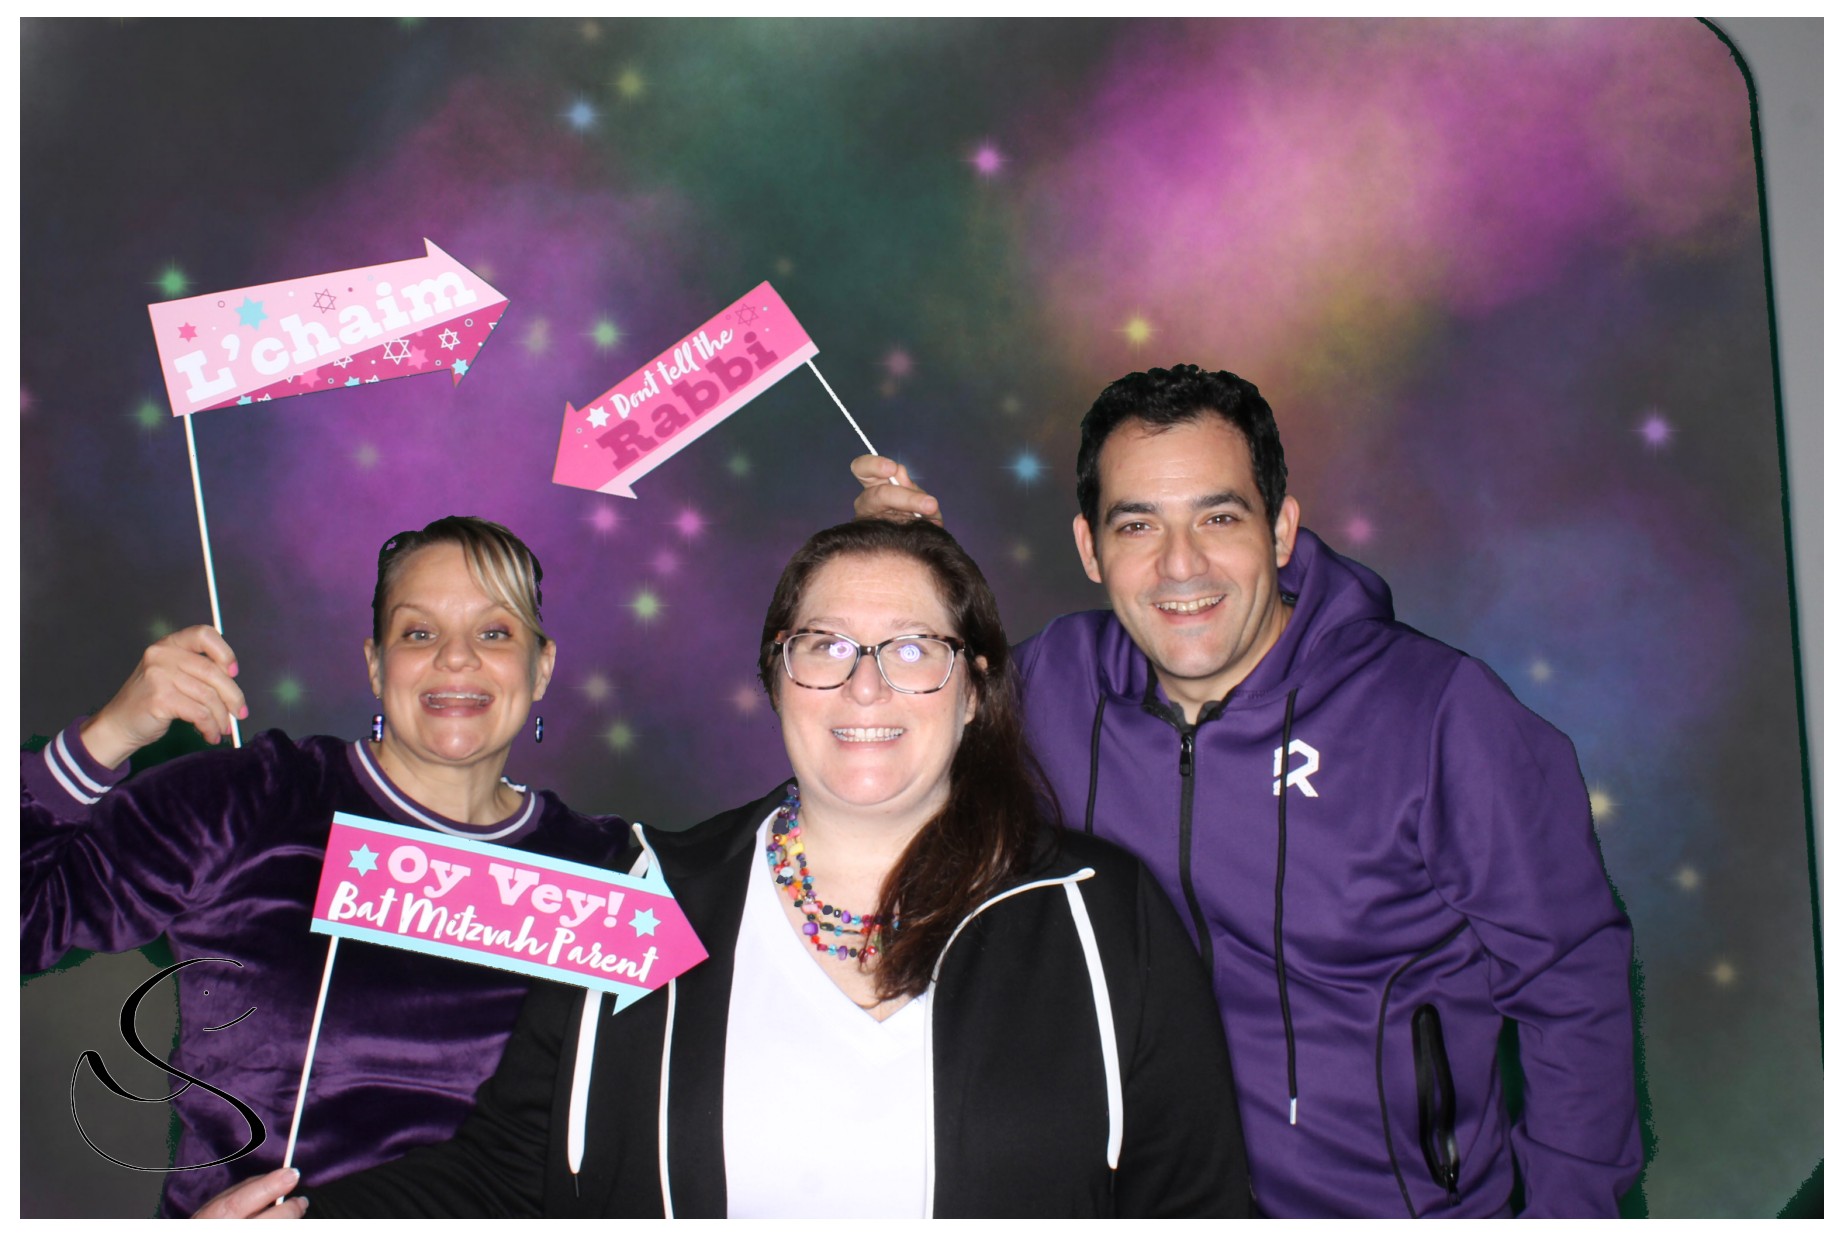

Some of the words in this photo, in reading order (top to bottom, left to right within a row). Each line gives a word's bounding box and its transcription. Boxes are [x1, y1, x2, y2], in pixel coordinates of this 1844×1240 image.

[173, 271, 478, 404] L'chaim
[610, 369, 661, 419] Don't
[657, 341, 700, 386] tell
[692, 328, 734, 361] the
[595, 331, 779, 471] Rabbi
[327, 881, 399, 928] Bat
[398, 892, 550, 956] Mitzvah
[546, 927, 659, 983] Parent
[387, 845, 471, 899] Oy
[488, 862, 626, 928] Vey!
